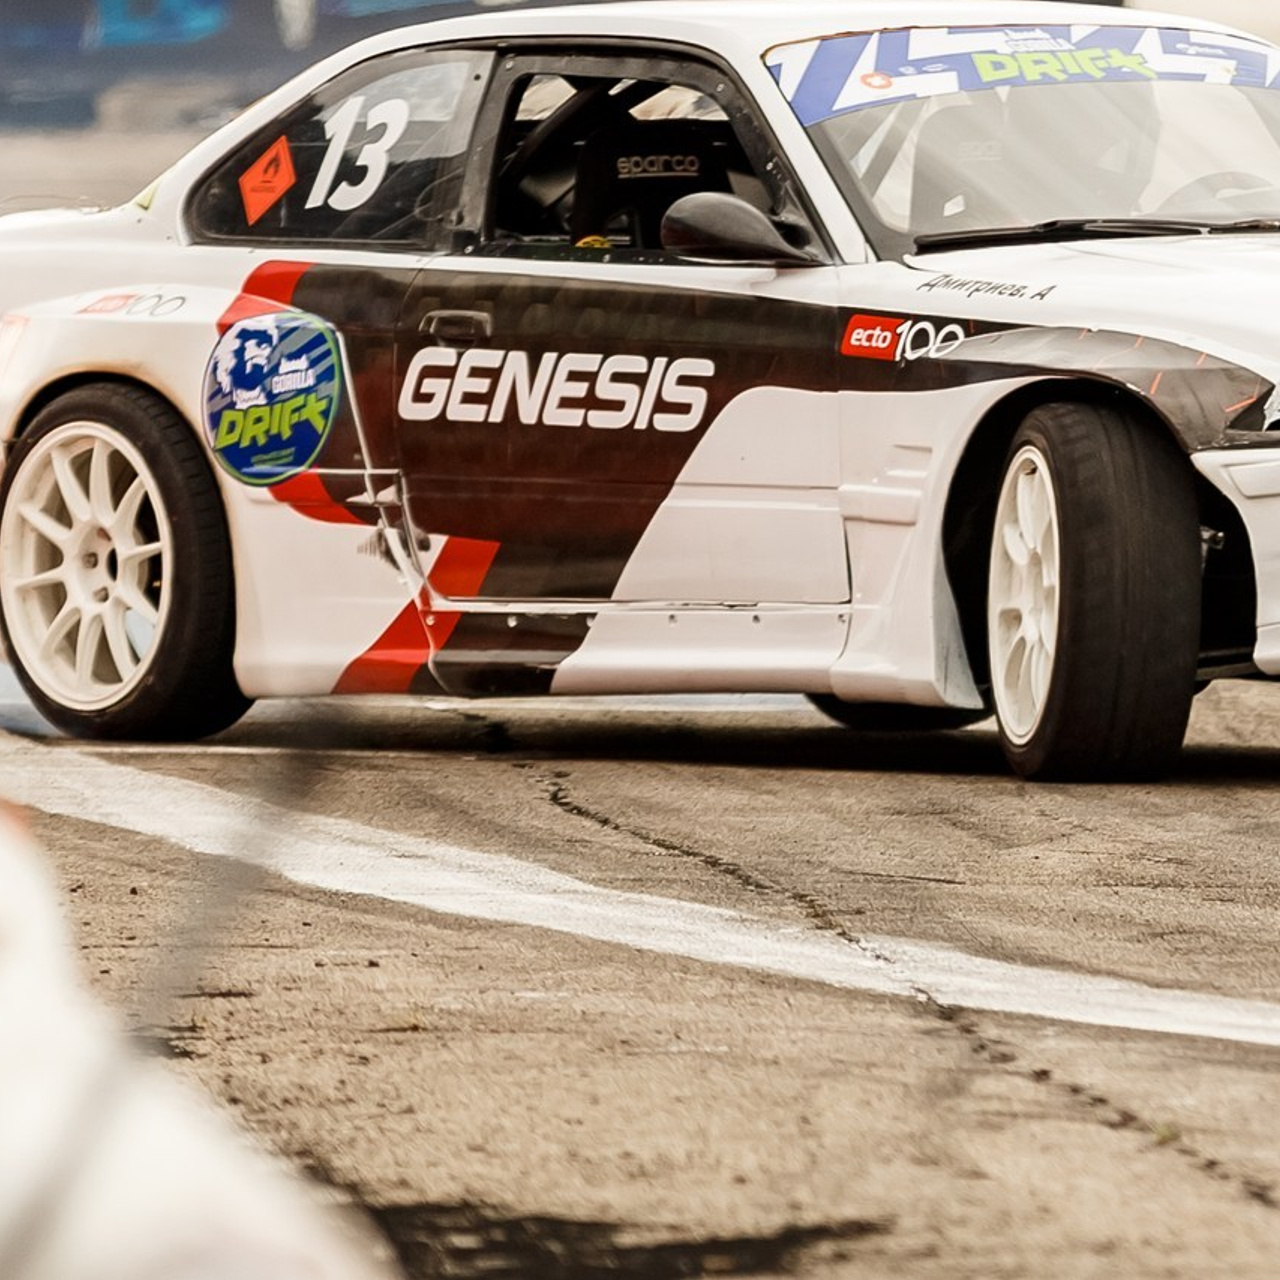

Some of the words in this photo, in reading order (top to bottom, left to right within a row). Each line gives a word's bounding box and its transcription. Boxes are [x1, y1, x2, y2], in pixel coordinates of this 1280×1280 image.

[971, 46, 1159, 83] DRIFT
[304, 95, 410, 211] 13
[1029, 285, 1057, 301] А
[397, 346, 716, 433] GENESIS
[214, 392, 330, 450] DRIFT
